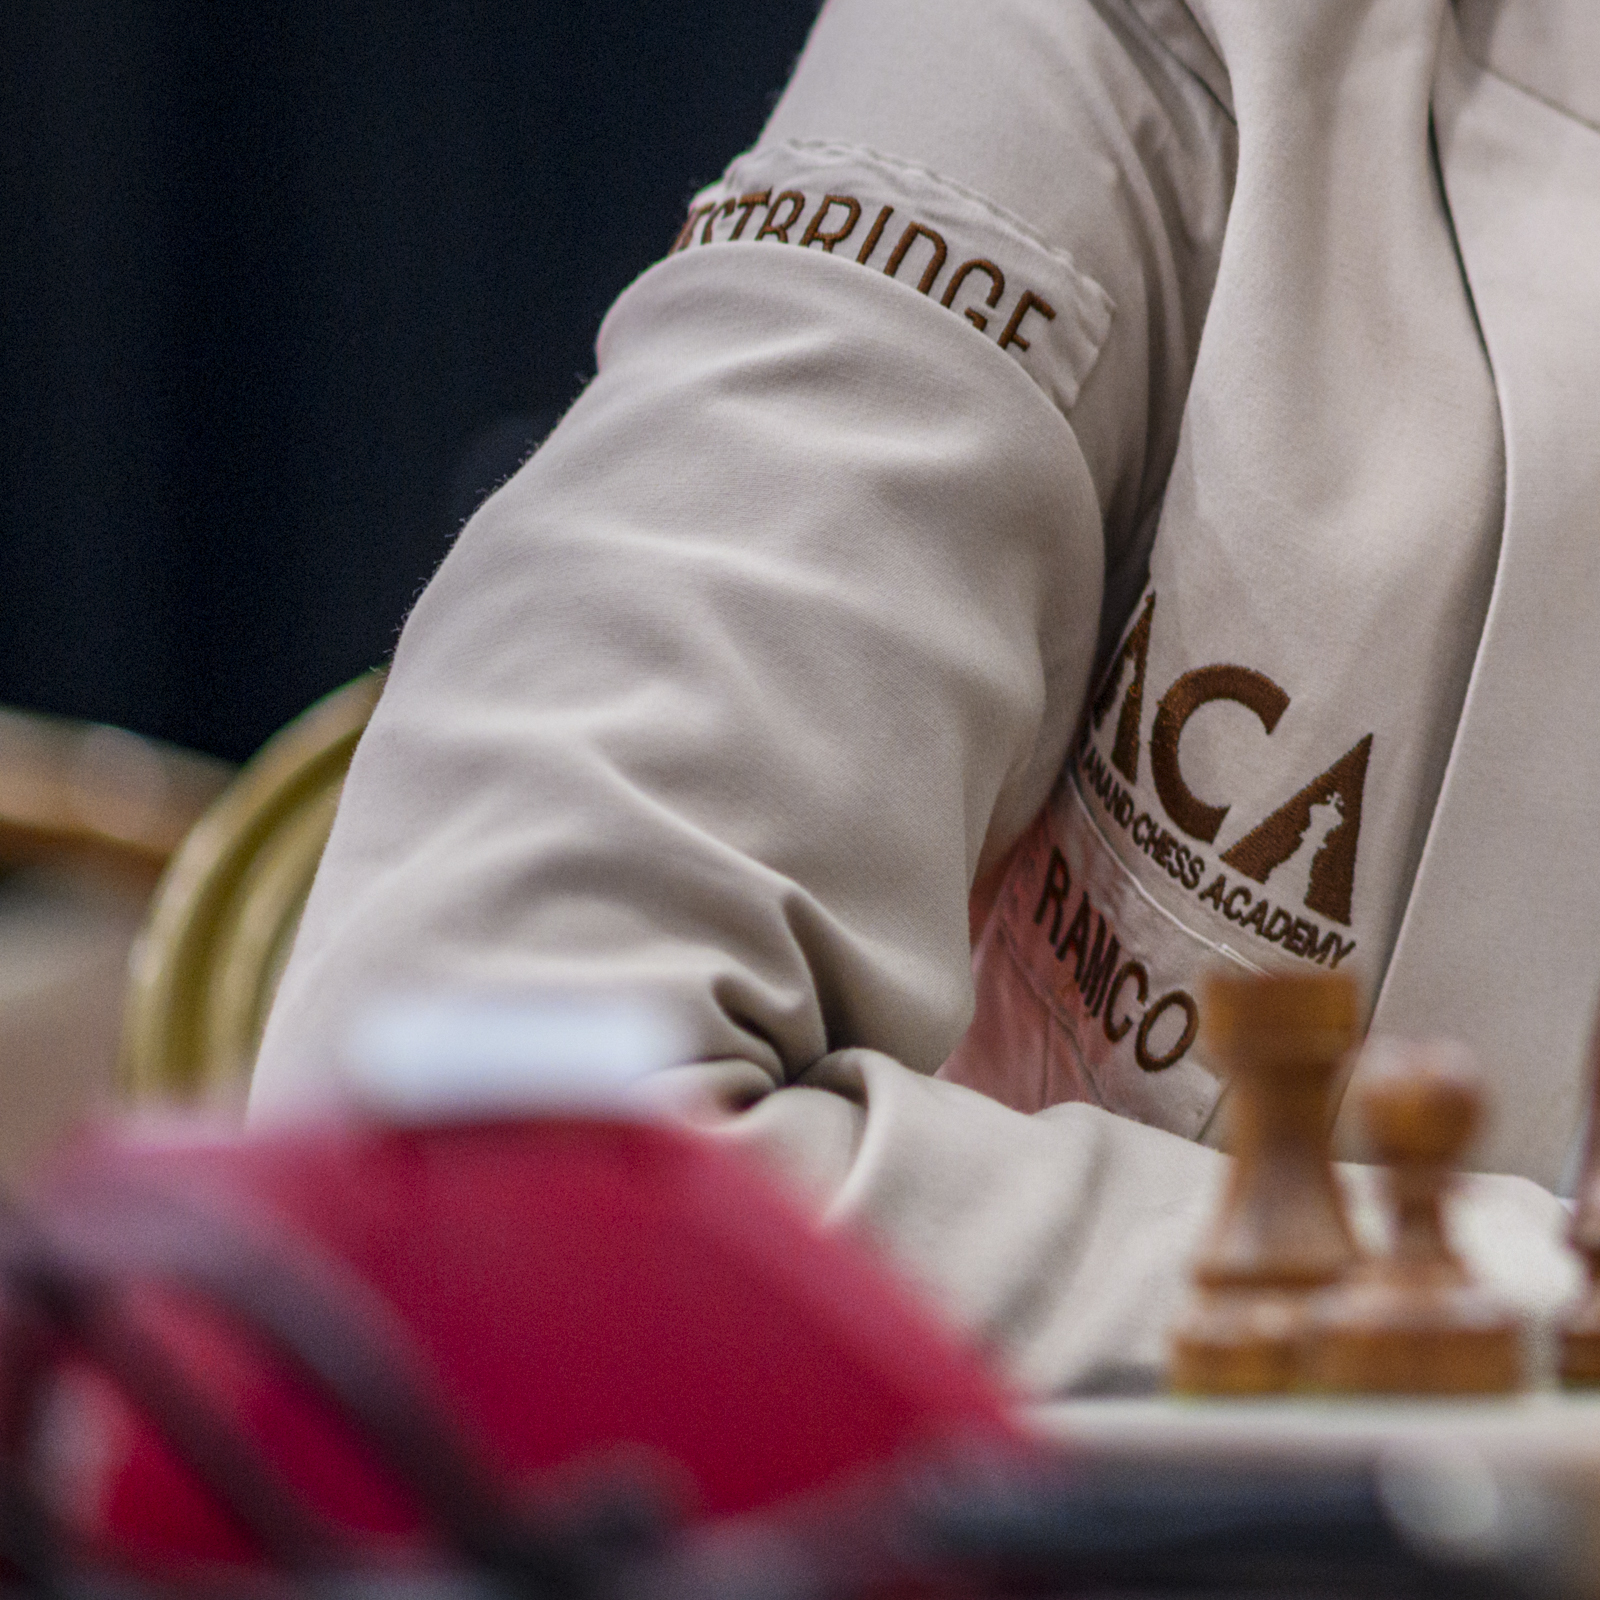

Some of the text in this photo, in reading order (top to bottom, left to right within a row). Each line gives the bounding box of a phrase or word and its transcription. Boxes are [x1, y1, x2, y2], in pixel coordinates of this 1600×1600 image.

[1033, 846, 1199, 1073] RAMCO
[1132, 812, 1205, 890] CHESS
[1198, 874, 1356, 970] ACADEMY
